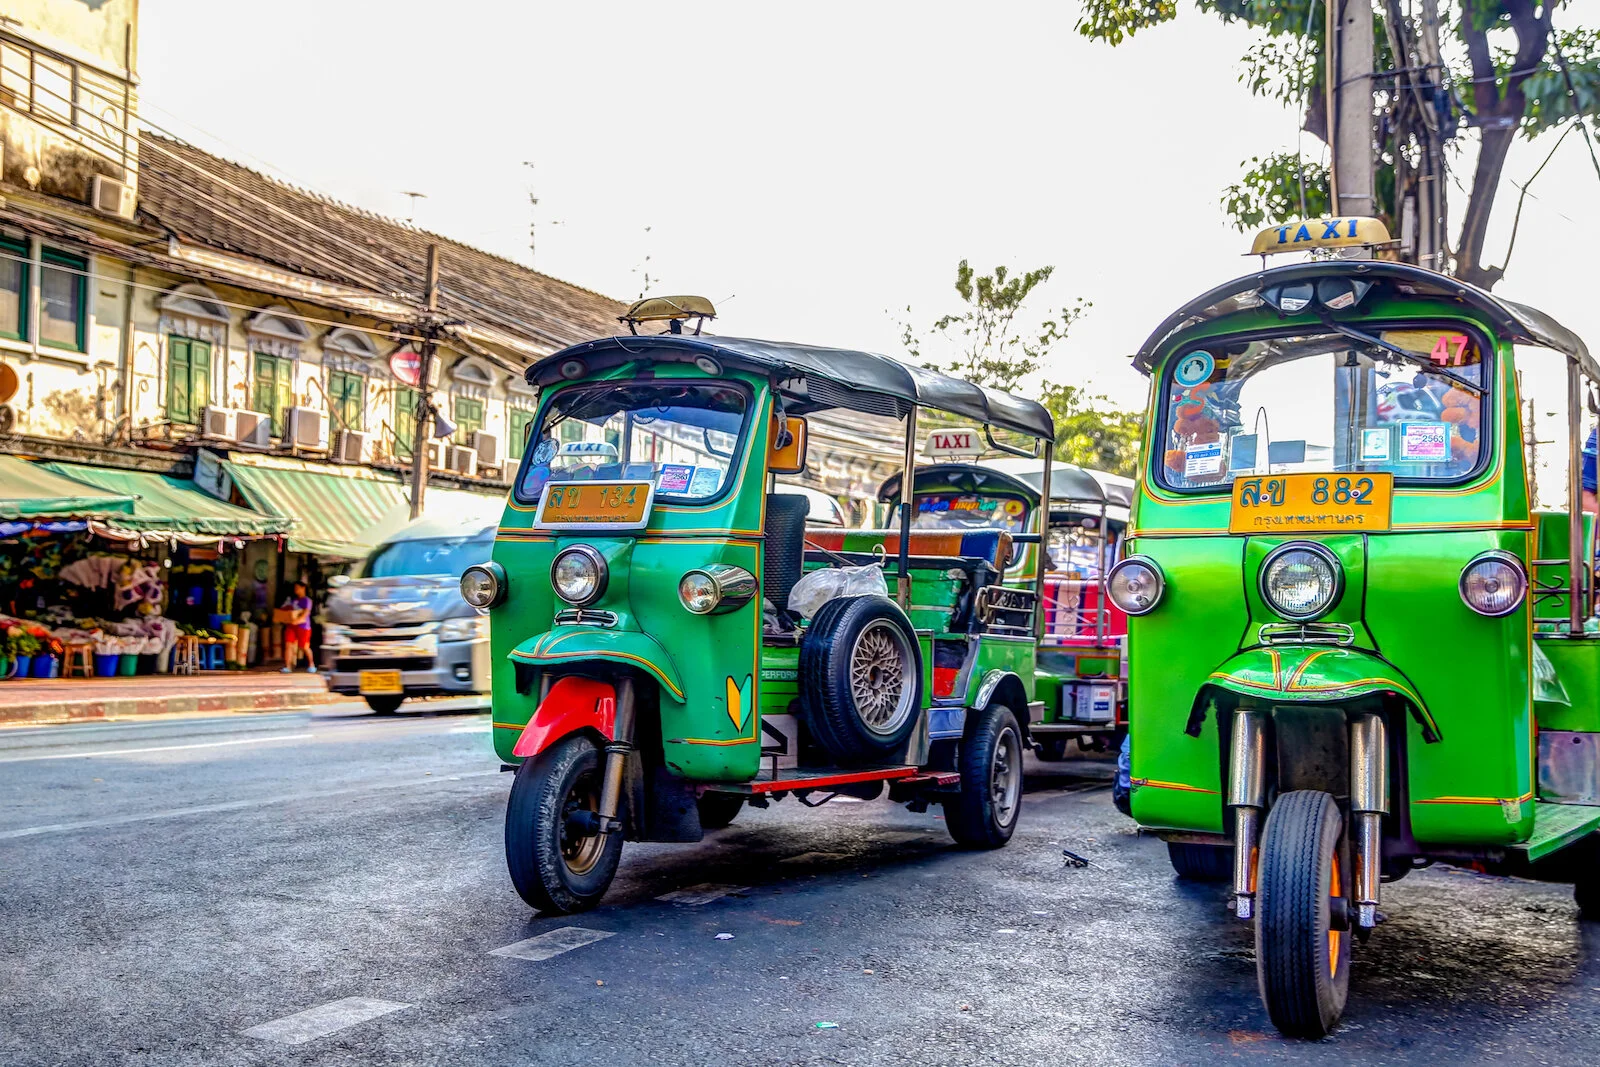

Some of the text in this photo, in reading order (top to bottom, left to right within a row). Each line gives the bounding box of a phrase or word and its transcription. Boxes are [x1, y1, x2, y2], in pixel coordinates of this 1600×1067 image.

[1274, 219, 1359, 244] TAXI
[1430, 335, 1469, 366] 47
[567, 443, 602, 452] TAXI
[932, 434, 971, 449] TAXI
[1421, 434, 1445, 444] 2563
[600, 486, 638, 508] 134
[1311, 477, 1374, 505] 882
